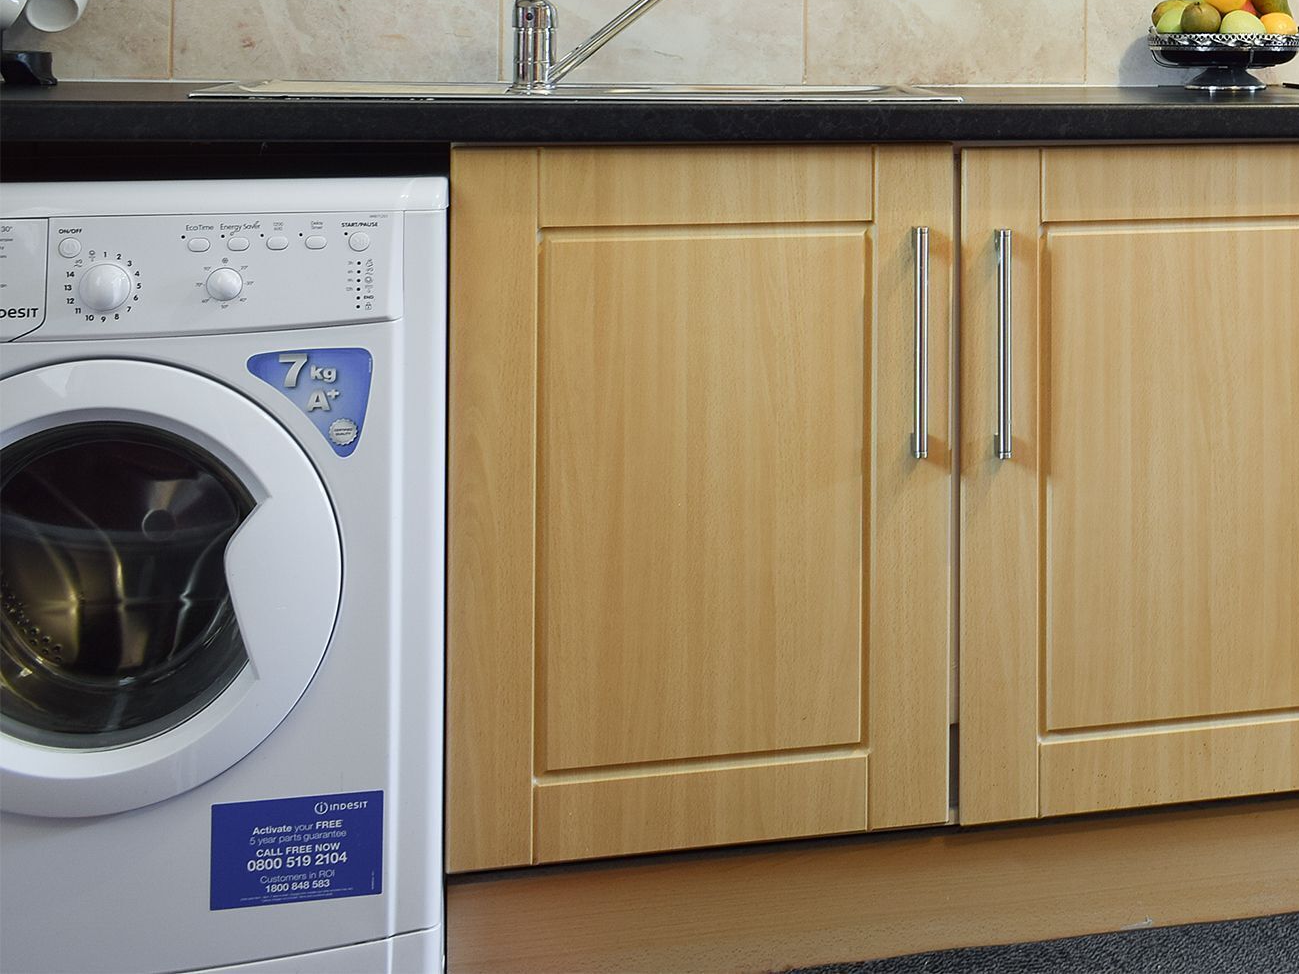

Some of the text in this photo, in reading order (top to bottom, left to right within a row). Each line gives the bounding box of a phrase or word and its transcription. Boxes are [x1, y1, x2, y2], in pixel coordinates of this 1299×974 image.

[220, 223, 242, 236] Energy
[278, 353, 308, 388] 7
[310, 364, 338, 383] kg
[306, 388, 340, 412] A+
[252, 825, 293, 836] Activate
[294, 823, 314, 834] your
[249, 830, 347, 847] 5 year parts guarantee
[255, 842, 341, 858] CALL FREE NOW
[247, 851, 348, 872] 0800 519 2104
[259, 869, 335, 884] Customers in ROI
[265, 879, 331, 893] 1800 848 583
